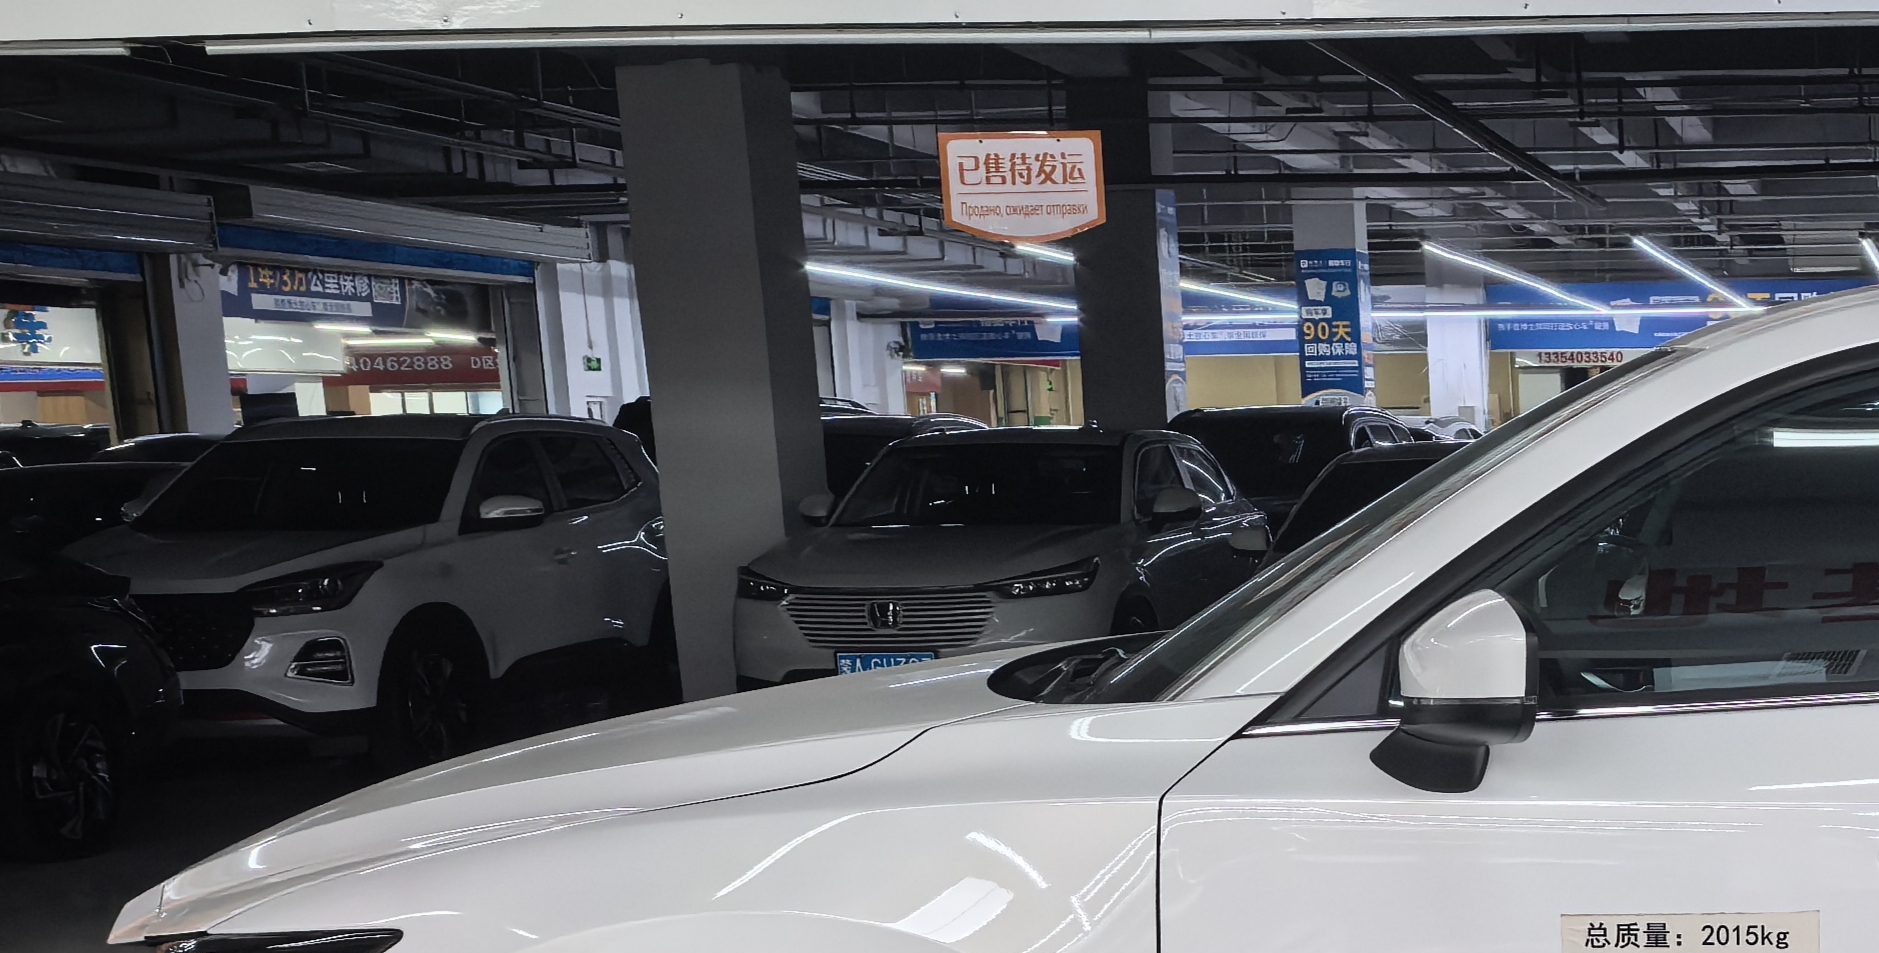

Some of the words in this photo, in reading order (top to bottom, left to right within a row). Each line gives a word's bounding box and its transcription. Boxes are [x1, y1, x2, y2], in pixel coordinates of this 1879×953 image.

[957, 152, 1086, 186] 已售待发运
[960, 202, 1004, 220] Продано,
[1005, 204, 1044, 219] ожидает
[1046, 203, 1089, 219] отправки
[1303, 321, 1352, 342] 90天
[1304, 342, 1358, 356] 回购保障
[1701, 924, 1790, 949] 2015kg
